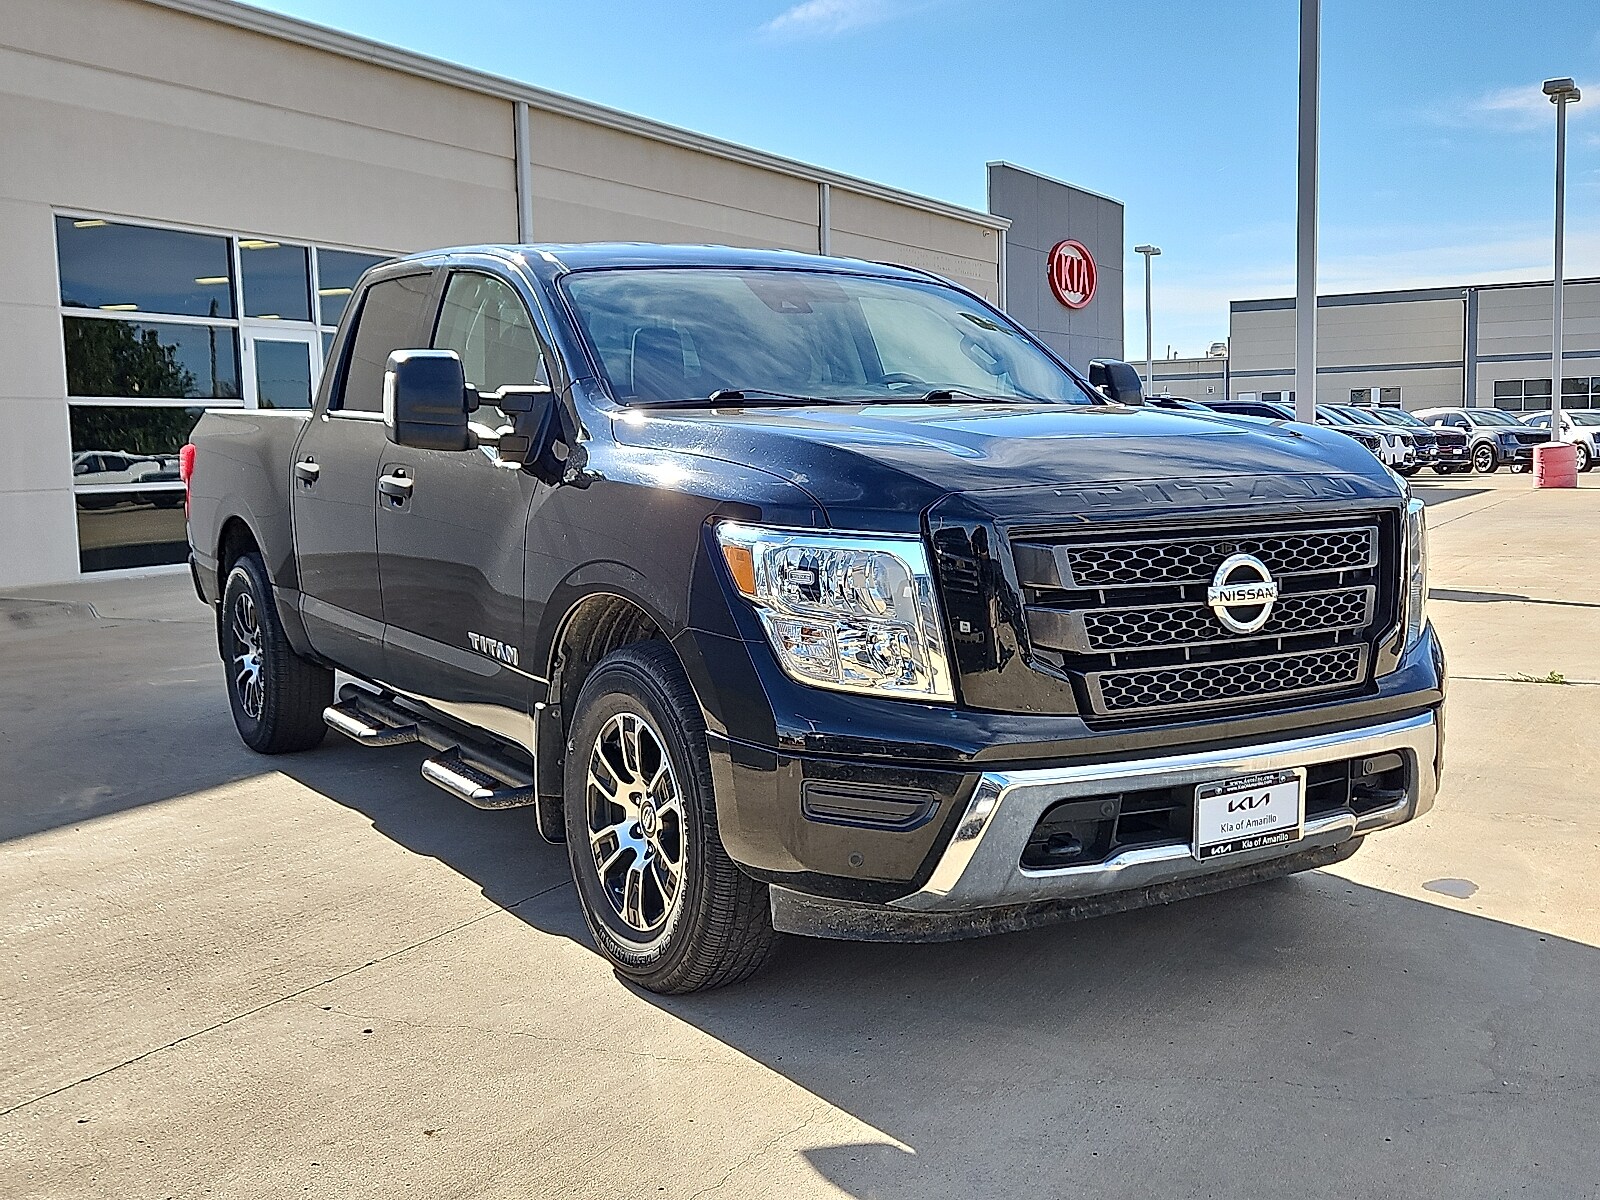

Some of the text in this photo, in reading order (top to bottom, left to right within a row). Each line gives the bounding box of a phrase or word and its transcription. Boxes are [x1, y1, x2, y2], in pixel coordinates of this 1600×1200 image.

[1061, 253, 1090, 295] KIA
[1053, 478, 1357, 506] TITAN
[1219, 586, 1274, 602] NISSAN
[467, 631, 519, 667] TITAN
[1220, 813, 1278, 834] Kia of Amarillo
[1242, 839, 1254, 849] Kia
[1254, 837, 1262, 846] of
[1262, 832, 1289, 845] Amarillo
